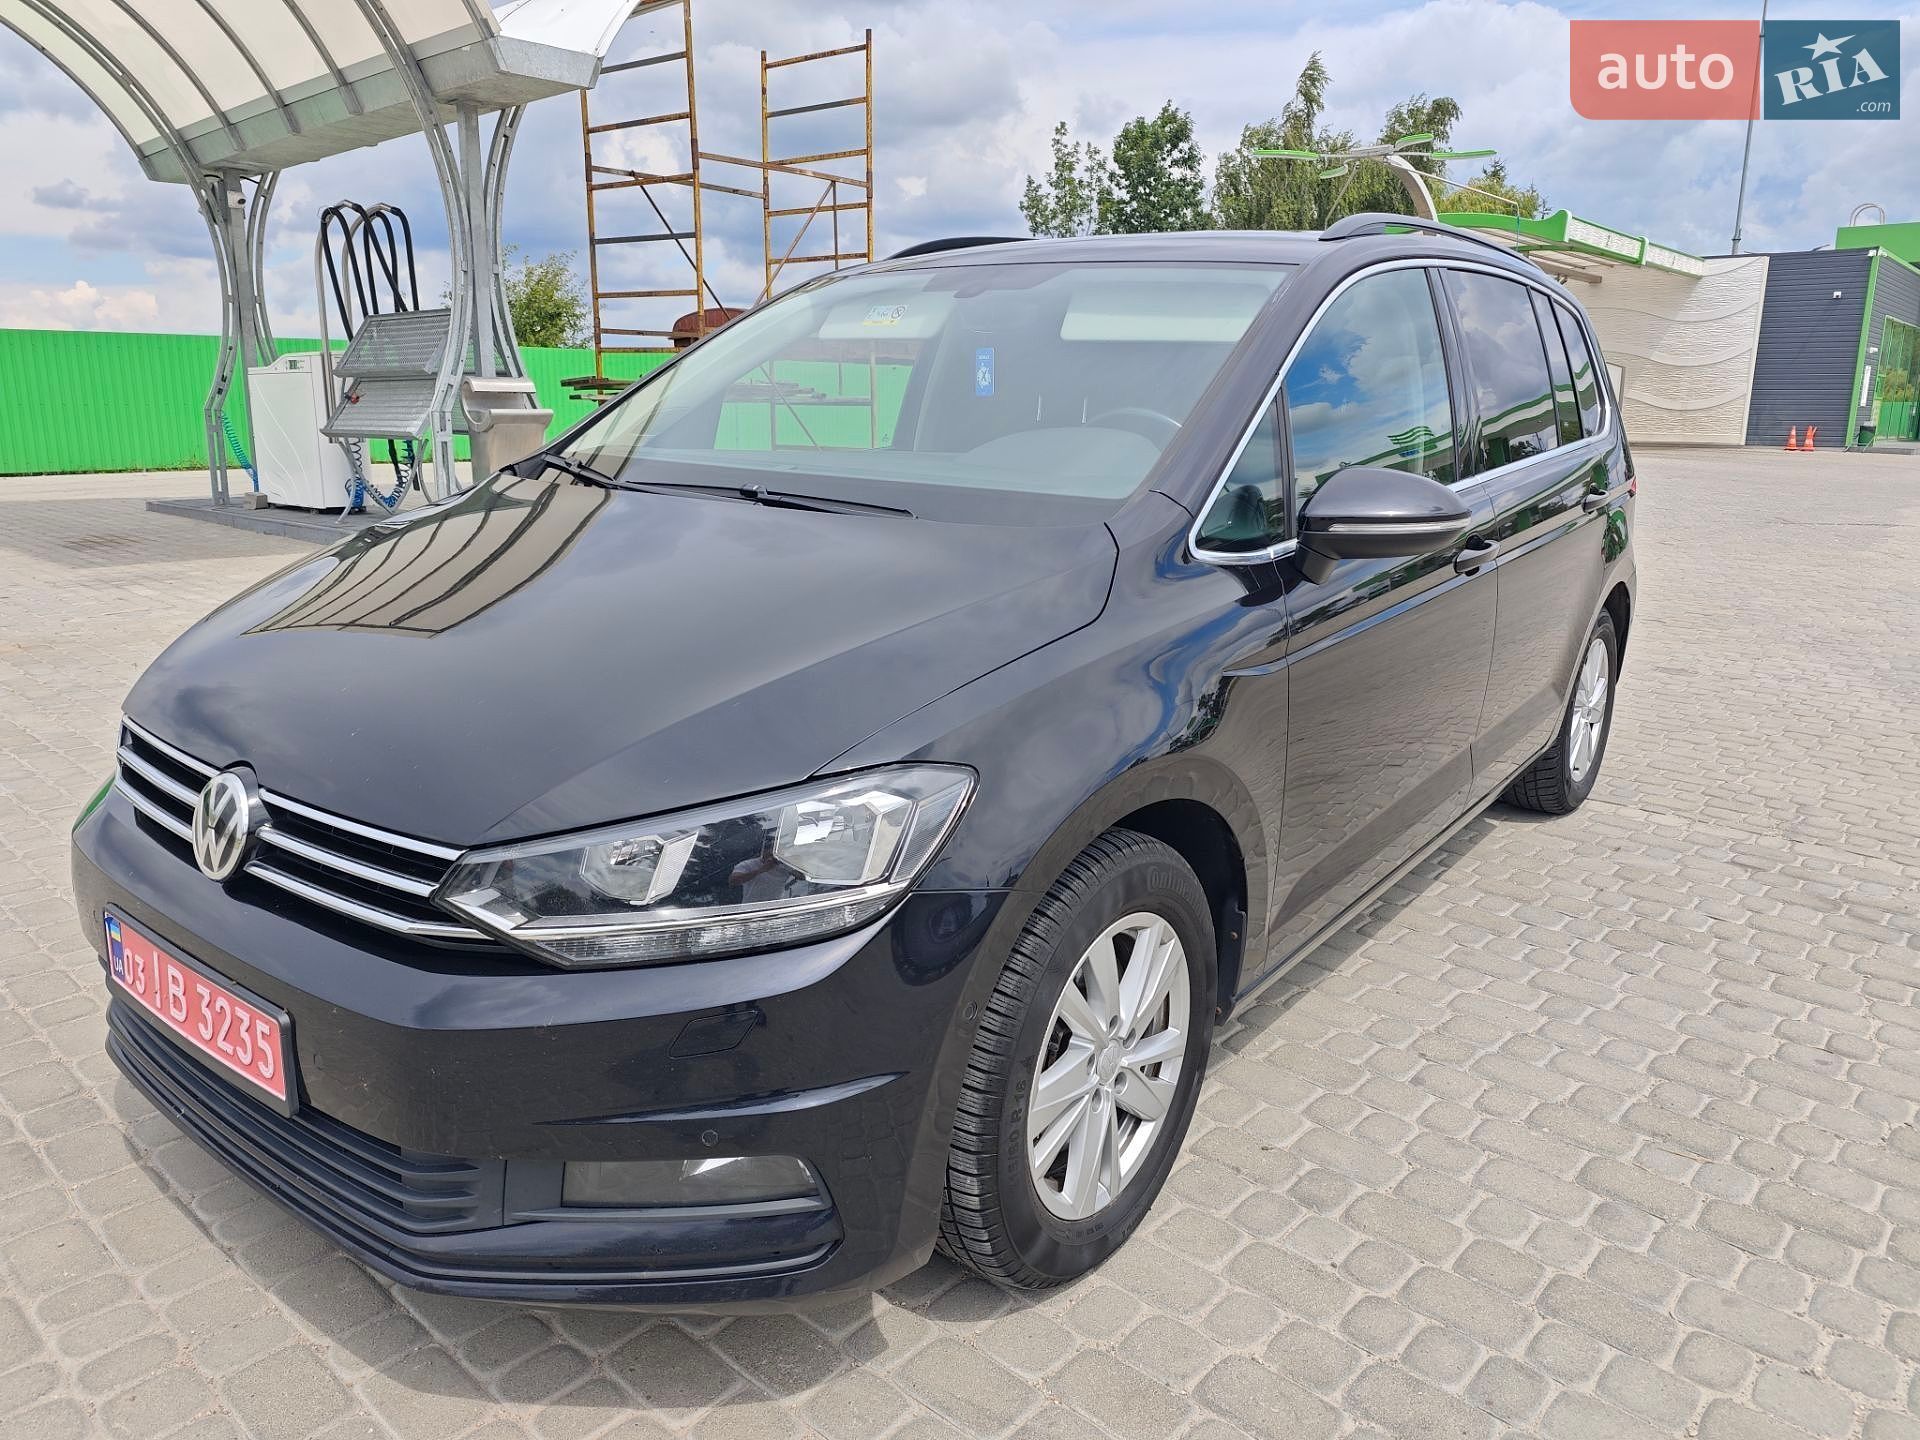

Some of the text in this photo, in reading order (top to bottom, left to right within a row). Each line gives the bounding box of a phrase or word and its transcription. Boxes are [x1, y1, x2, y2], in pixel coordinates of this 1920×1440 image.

[113, 954, 124, 976] UA
[123, 948, 146, 995] 03
[196, 983, 275, 1080] 3235
